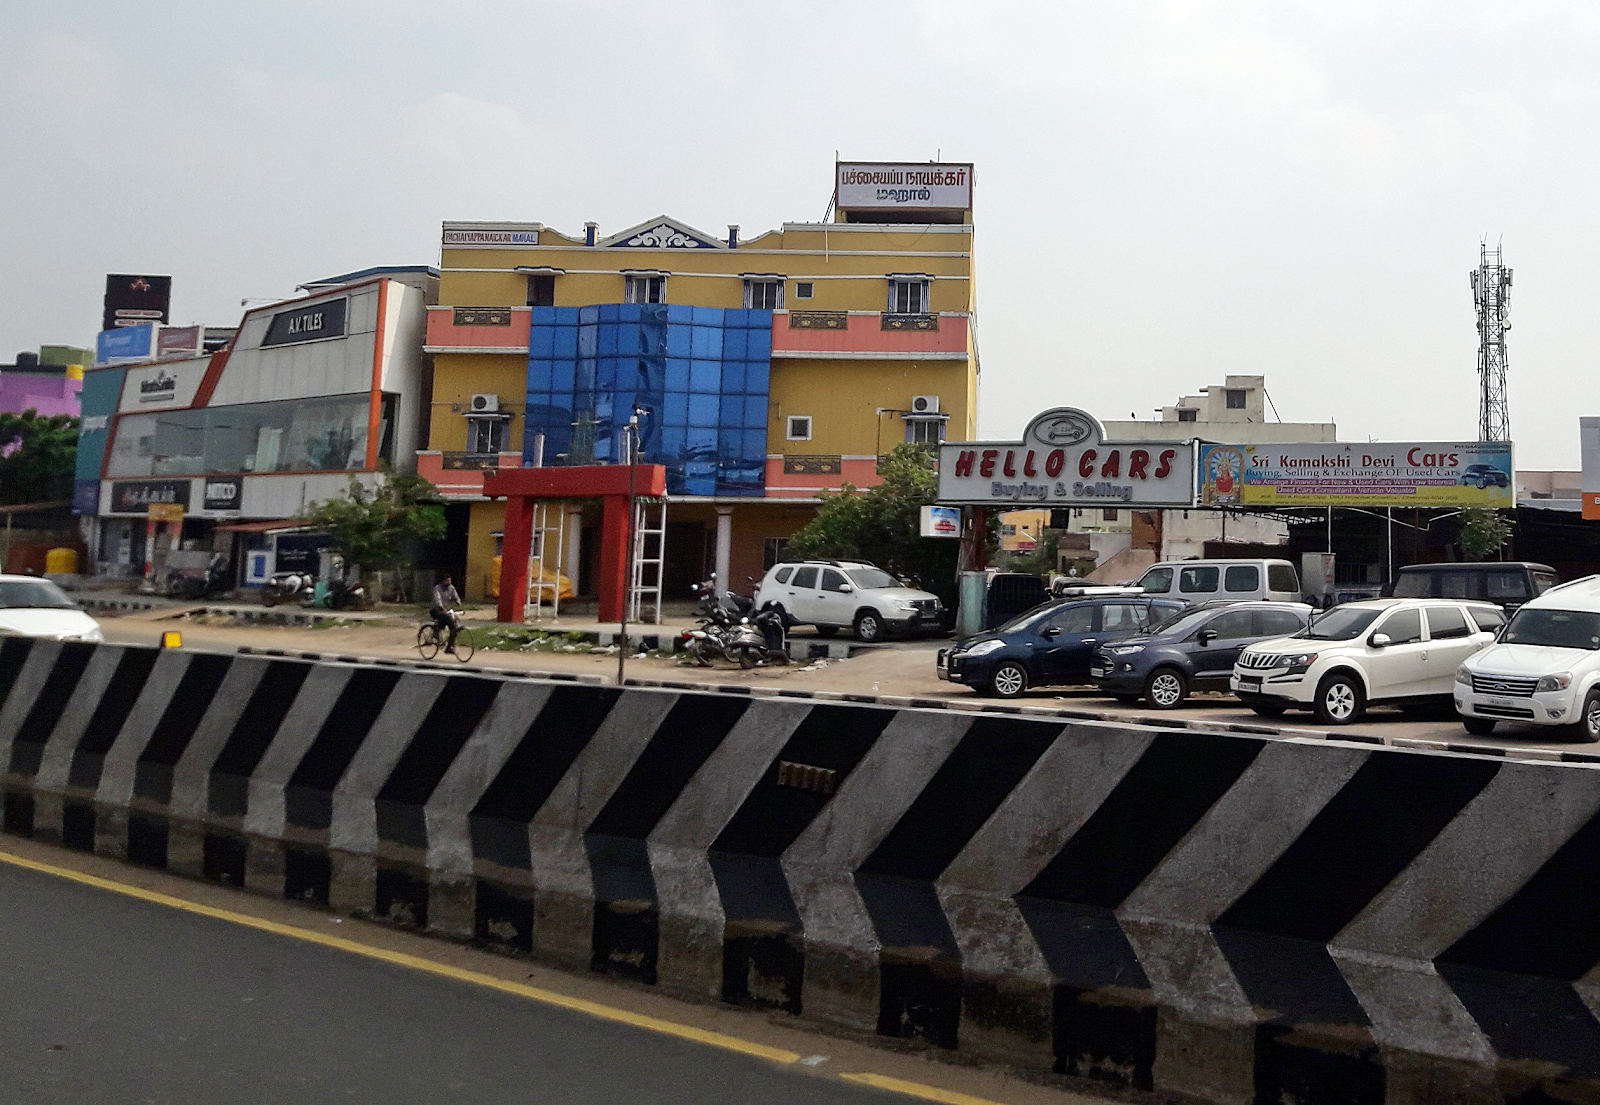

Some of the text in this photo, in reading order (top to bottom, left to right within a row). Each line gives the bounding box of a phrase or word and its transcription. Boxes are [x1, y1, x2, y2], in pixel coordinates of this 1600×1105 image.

[955, 449, 1176, 479] HELLO CARS
[1252, 447, 1459, 468] Sri Kamakshi Devi Cars
[1286, 469, 1319, 478] Selling
[1334, 469, 1383, 478] Exchange
[991, 481, 1133, 500] Buying & Selling
